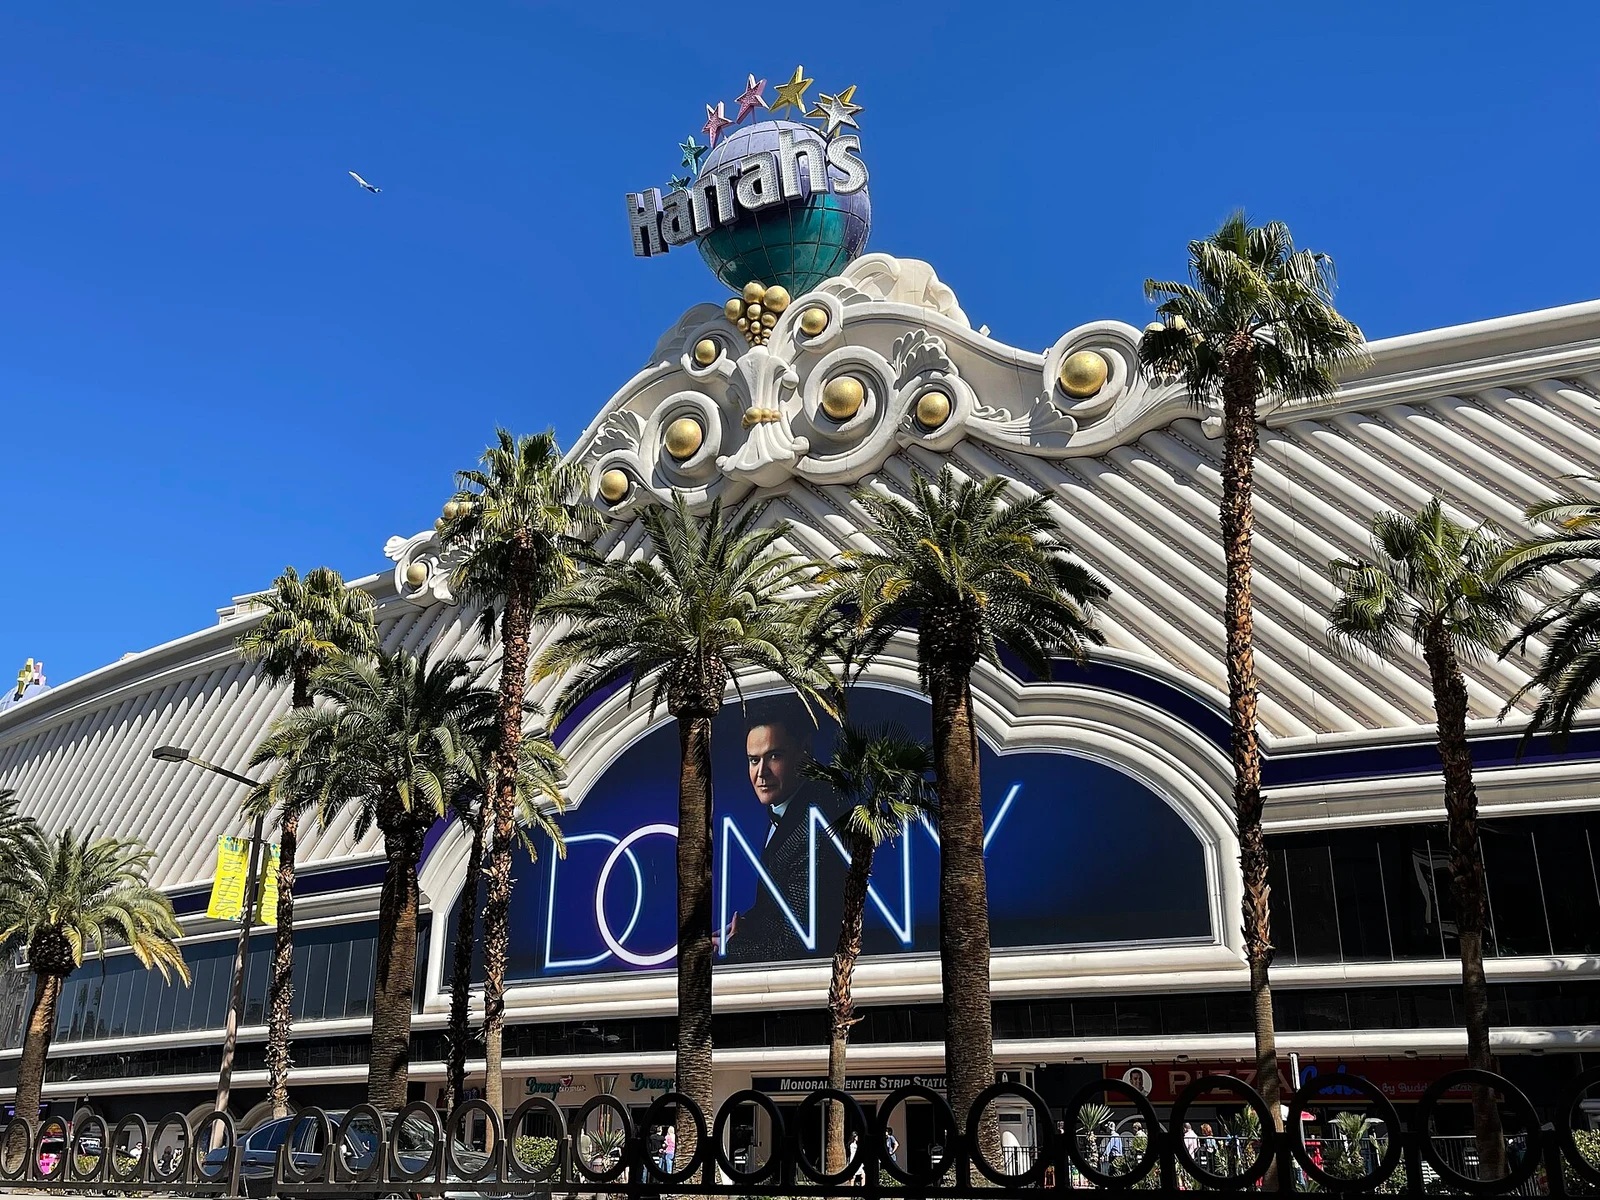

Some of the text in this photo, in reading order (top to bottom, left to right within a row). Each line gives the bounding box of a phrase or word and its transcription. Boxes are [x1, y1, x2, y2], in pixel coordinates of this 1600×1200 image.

[214, 852, 243, 913] LAS VEGAS
[780, 1076, 947, 1090] MONORAI ENTER STRIP STATIO
[1397, 1082, 1429, 1092] Budd
